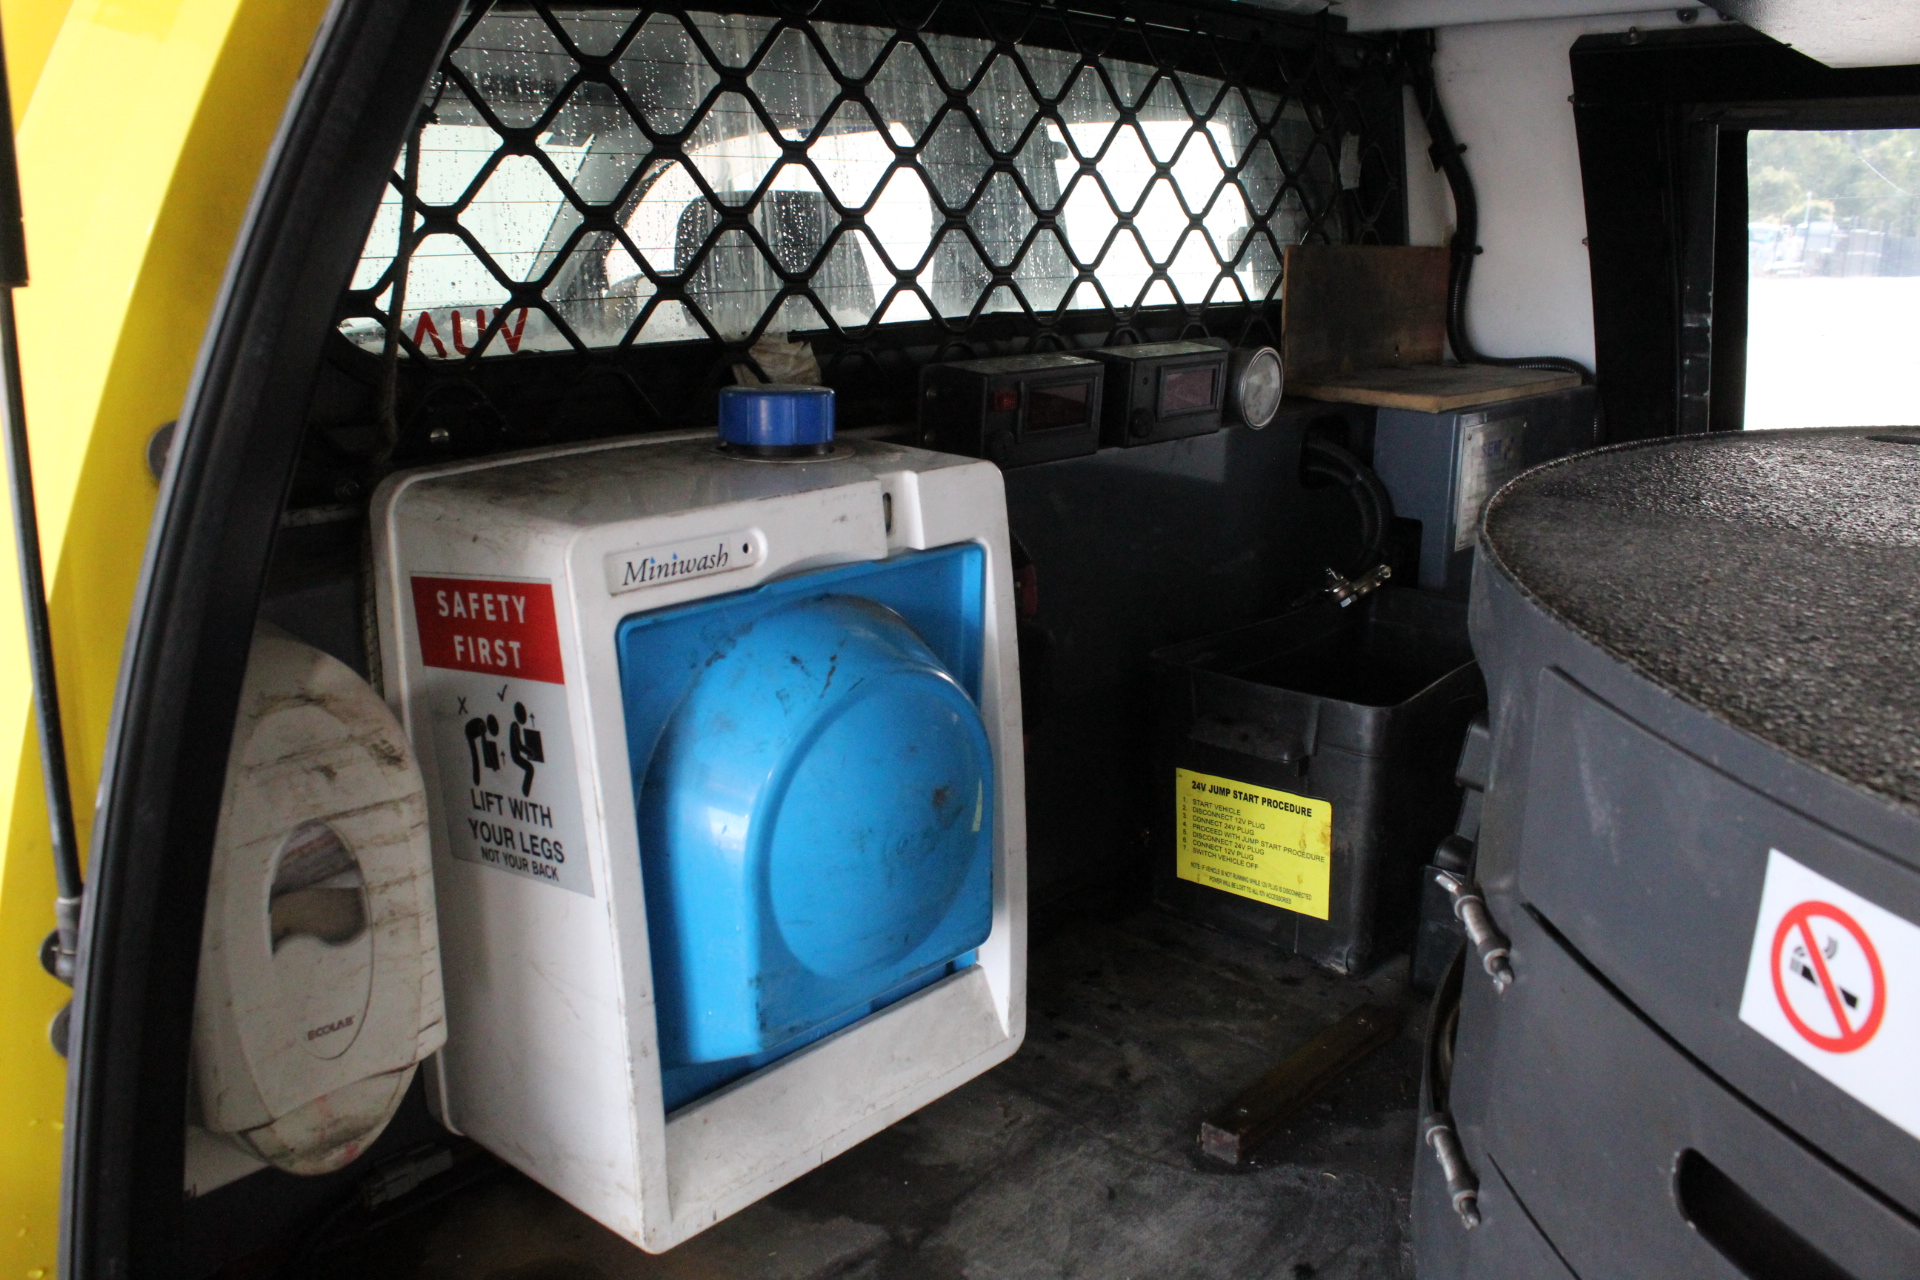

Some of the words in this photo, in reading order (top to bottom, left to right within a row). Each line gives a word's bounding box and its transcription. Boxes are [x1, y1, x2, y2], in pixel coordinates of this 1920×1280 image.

[622, 543, 728, 587] Miniwash
[437, 590, 526, 624] SAFETY
[454, 635, 521, 669] FIRST
[471, 788, 503, 816] LIFT
[509, 798, 553, 829] WITH
[1192, 781, 1206, 792] 24V
[1209, 786, 1230, 796] JUMP
[1233, 791, 1259, 804] START
[1262, 797, 1312, 817] PROCEDURE
[1193, 799, 1212, 809] START
[1214, 804, 1241, 815] VEHICLE
[1193, 807, 1233, 821] DISCONNECT
[1248, 820, 1265, 829] PLUG
[1193, 815, 1222, 827] CONNECT
[1237, 826, 1254, 835] PLUG
[468, 818, 514, 851] YOUR
[521, 832, 565, 864] LEGS
[1193, 824, 1222, 836] PROCEED
[1224, 831, 1240, 840] WITH
[1242, 837, 1259, 845] JUMP
[1261, 841, 1282, 851] START
[1283, 847, 1325, 862] PROCEDURE
[1193, 832, 1232, 846] DISCONNECT
[1247, 845, 1264, 855] PLUG
[1193, 840, 1222, 852] CONNECT
[1237, 850, 1254, 860] PLUG
[1193, 848, 1217, 860] SWITCH
[1218, 854, 1244, 867] VEHICLE
[481, 847, 500, 864] NOT
[503, 853, 529, 872] YOUR
[533, 860, 559, 882] BACK
[1205, 865, 1220, 874] VEHICLE
[1233, 873, 1249, 883] RUNNING
[1269, 883, 1278, 891] PLUG
[1283, 887, 1312, 900] DISCONNECTED
[1209, 876, 1222, 884] POWER
[1237, 883, 1245, 891] LOST
[1266, 892, 1291, 904] ACCESSORIES
[307, 1016, 354, 1041] ECOLAB
